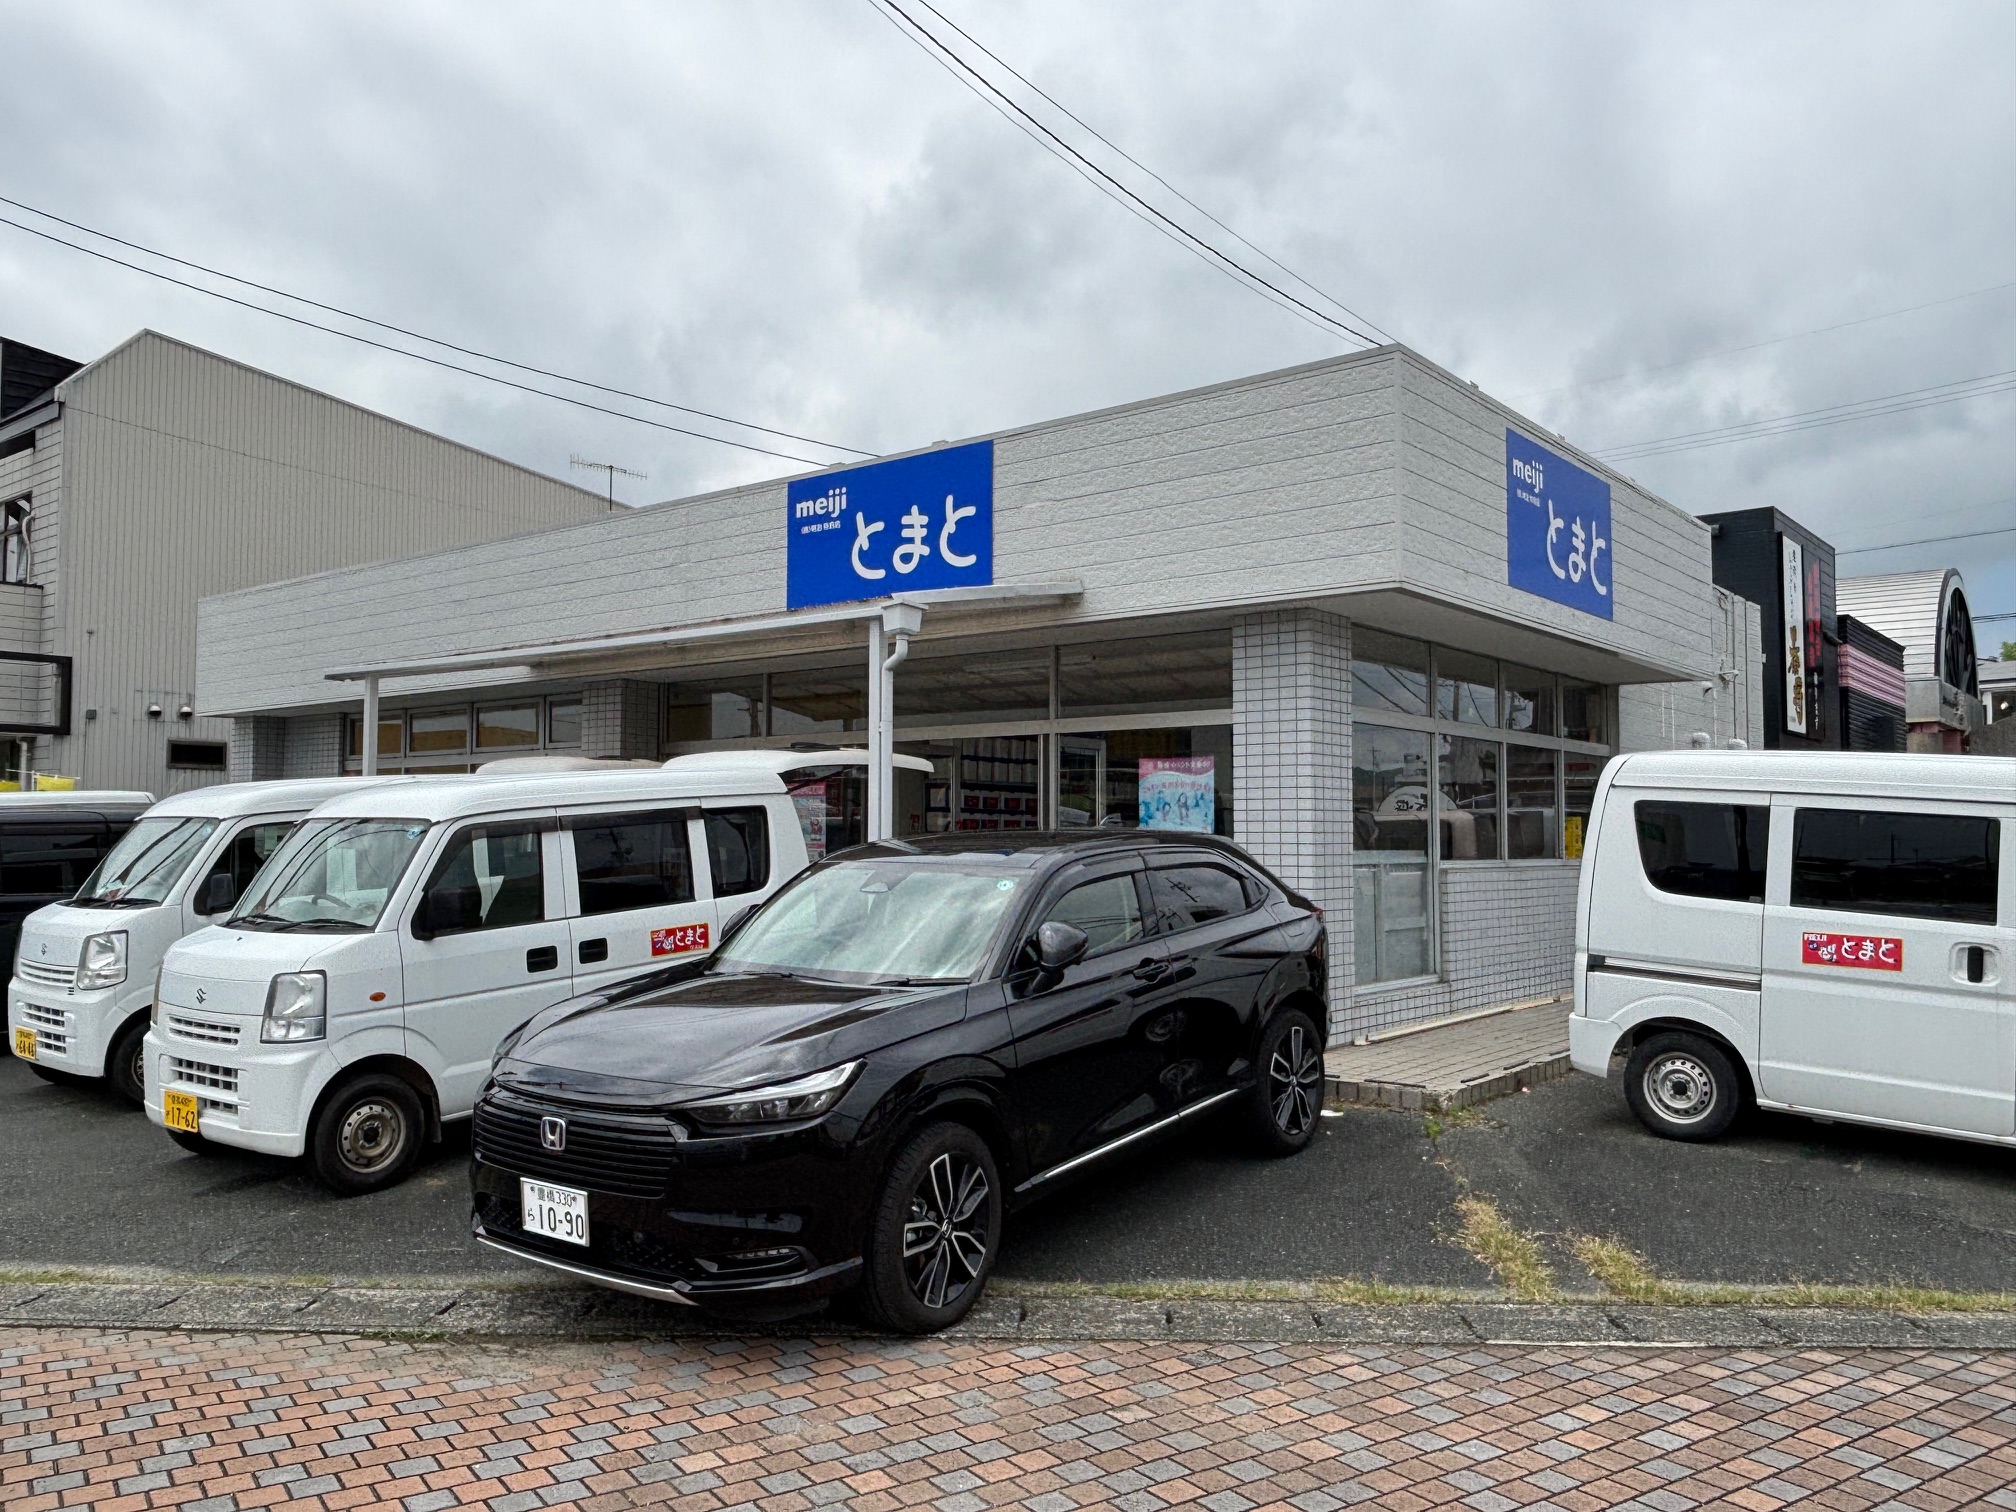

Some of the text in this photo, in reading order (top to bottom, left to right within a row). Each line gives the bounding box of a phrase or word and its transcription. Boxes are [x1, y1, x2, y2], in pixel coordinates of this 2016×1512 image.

[1512, 457, 1543, 493] meiji
[796, 487, 847, 518] meiji
[851, 494, 977, 580] とまと
[1546, 499, 1607, 595] とまと
[675, 925, 706, 946] とまと
[1841, 937, 1897, 963] とまと
[172, 1106, 196, 1129] 17-62
[539, 1204, 584, 1240] 10-90
